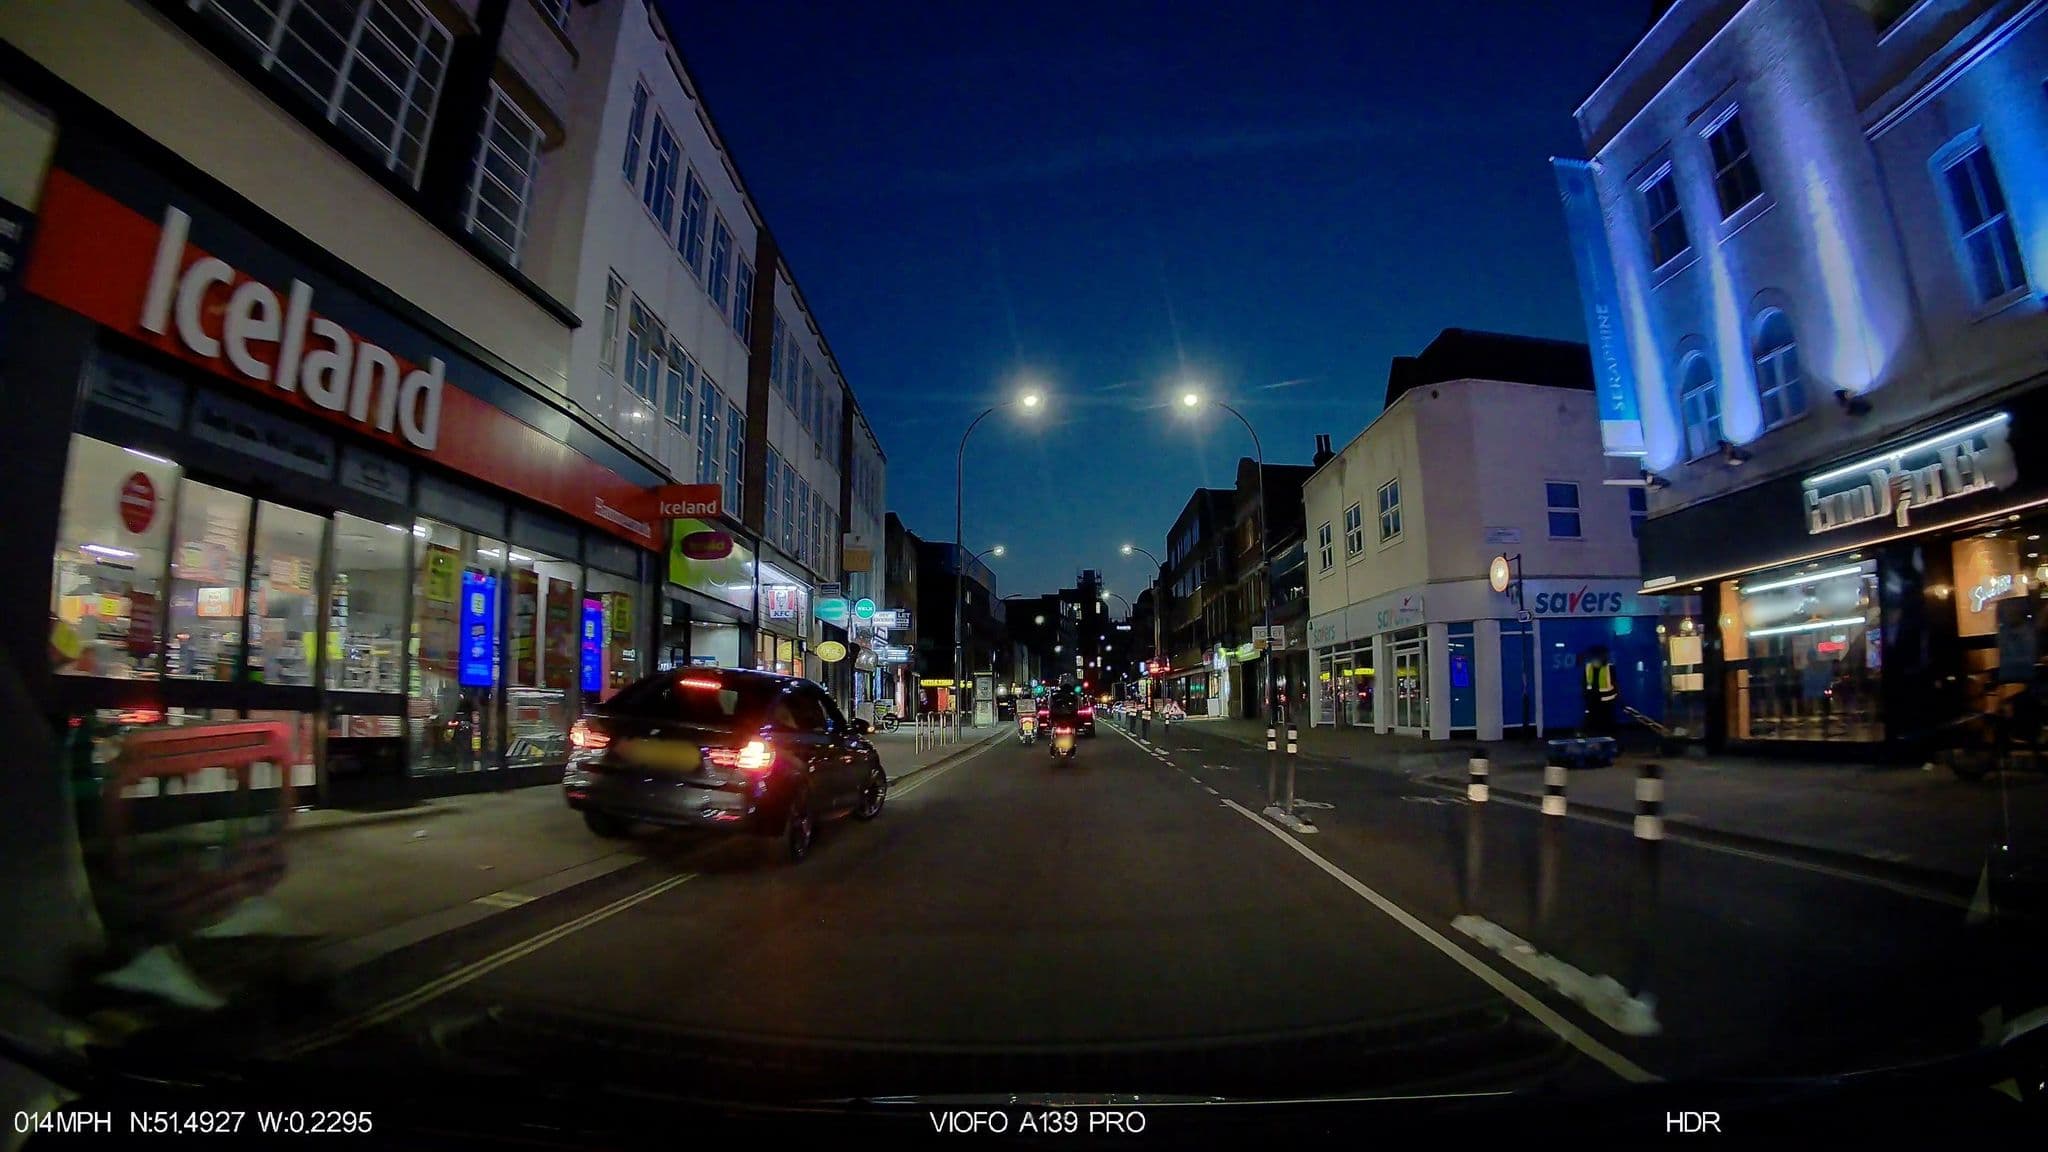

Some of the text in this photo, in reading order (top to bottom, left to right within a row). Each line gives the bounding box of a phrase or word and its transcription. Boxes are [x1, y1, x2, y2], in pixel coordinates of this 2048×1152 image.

[140, 205, 445, 451] Iceland
[660, 500, 717, 515] Iceland
[1535, 585, 1623, 614] savers
